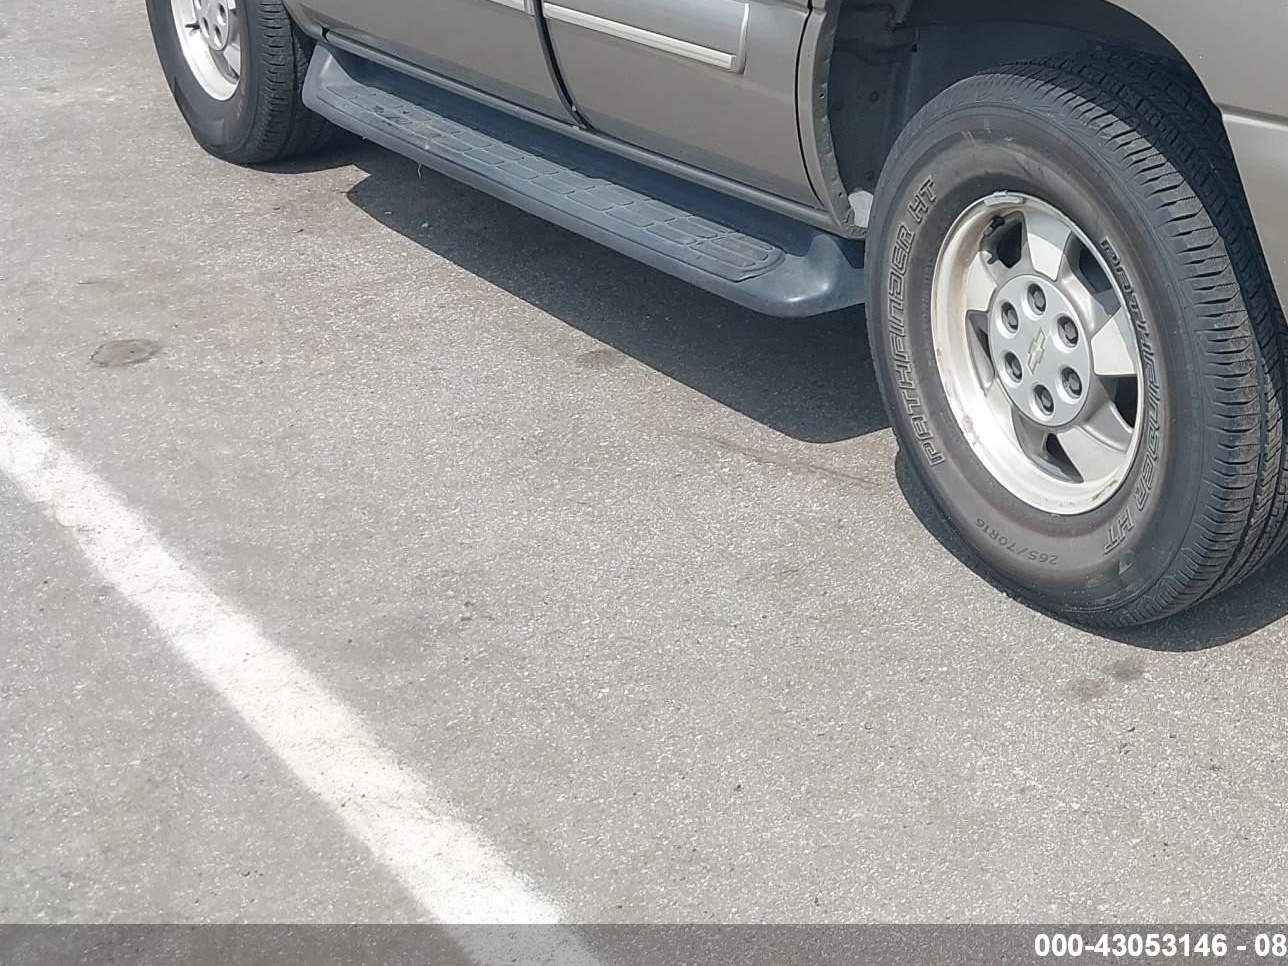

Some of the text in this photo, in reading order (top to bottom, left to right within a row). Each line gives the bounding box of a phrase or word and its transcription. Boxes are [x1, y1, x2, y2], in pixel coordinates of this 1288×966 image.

[888, 175, 945, 466] PATHFINDER HT
[1100, 237, 1161, 555] PATHFINDER HT
[975, 517, 1059, 566] 265/70R16
